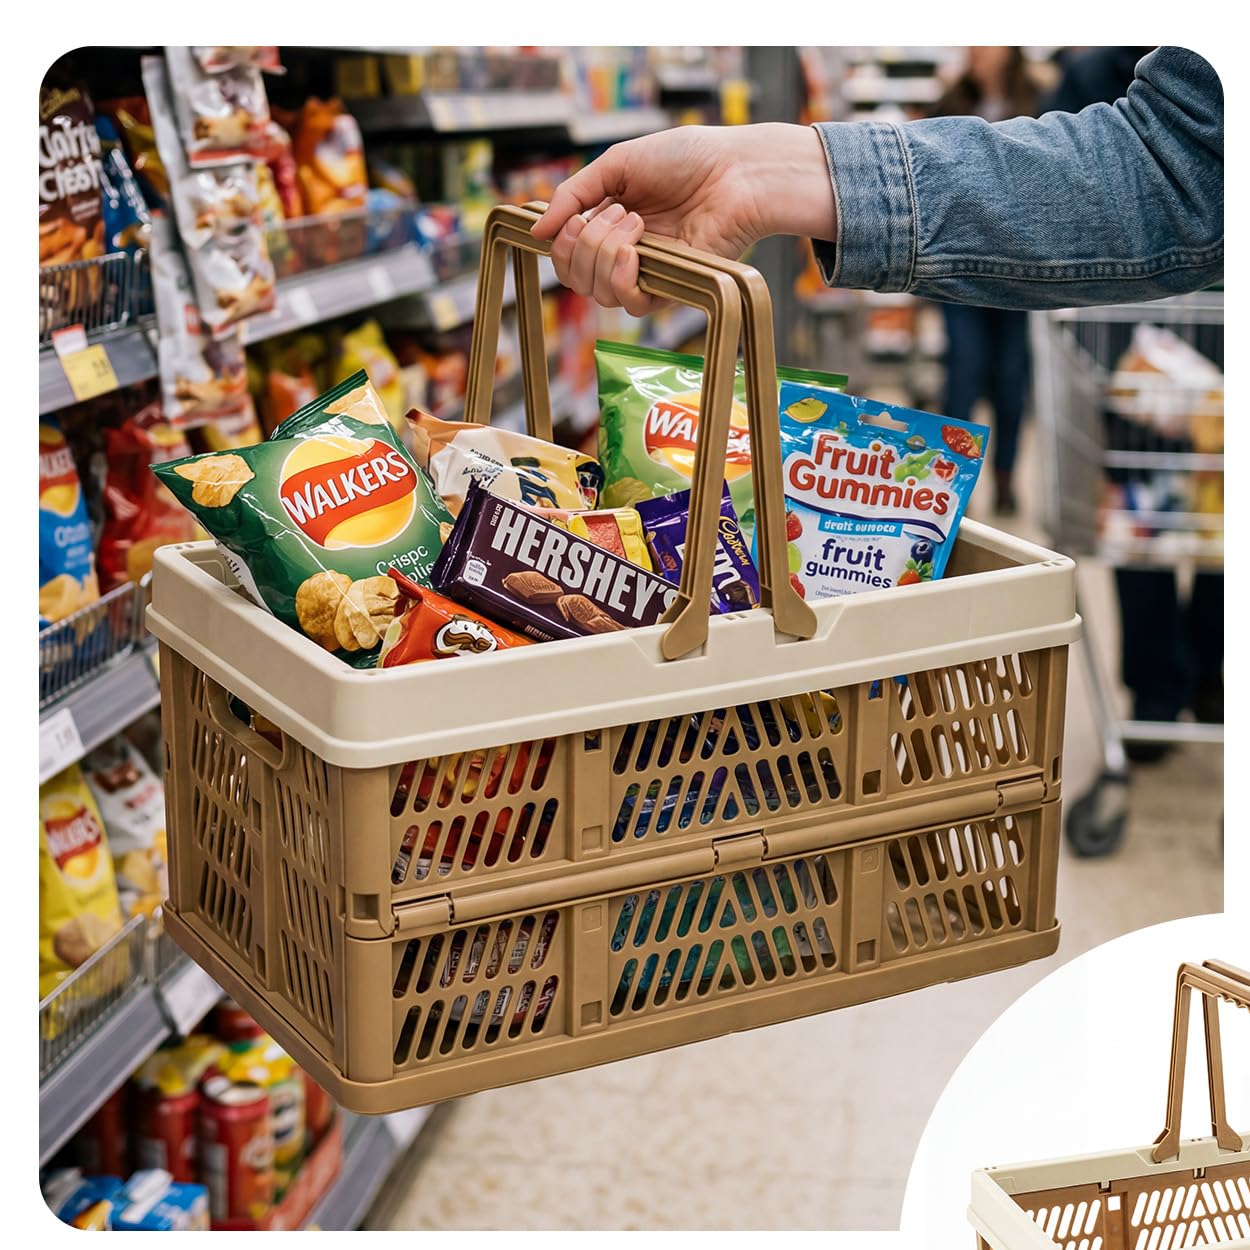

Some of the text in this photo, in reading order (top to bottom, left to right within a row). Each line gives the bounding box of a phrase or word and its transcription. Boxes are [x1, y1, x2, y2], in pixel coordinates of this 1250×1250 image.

[814, 434, 895, 479] Fruit
[281, 451, 409, 525] WALKERS
[789, 458, 950, 515] Gummies
[491, 507, 680, 624] HERSHEY'S
[805, 560, 892, 588] gummies
[822, 538, 885, 571] fruit
